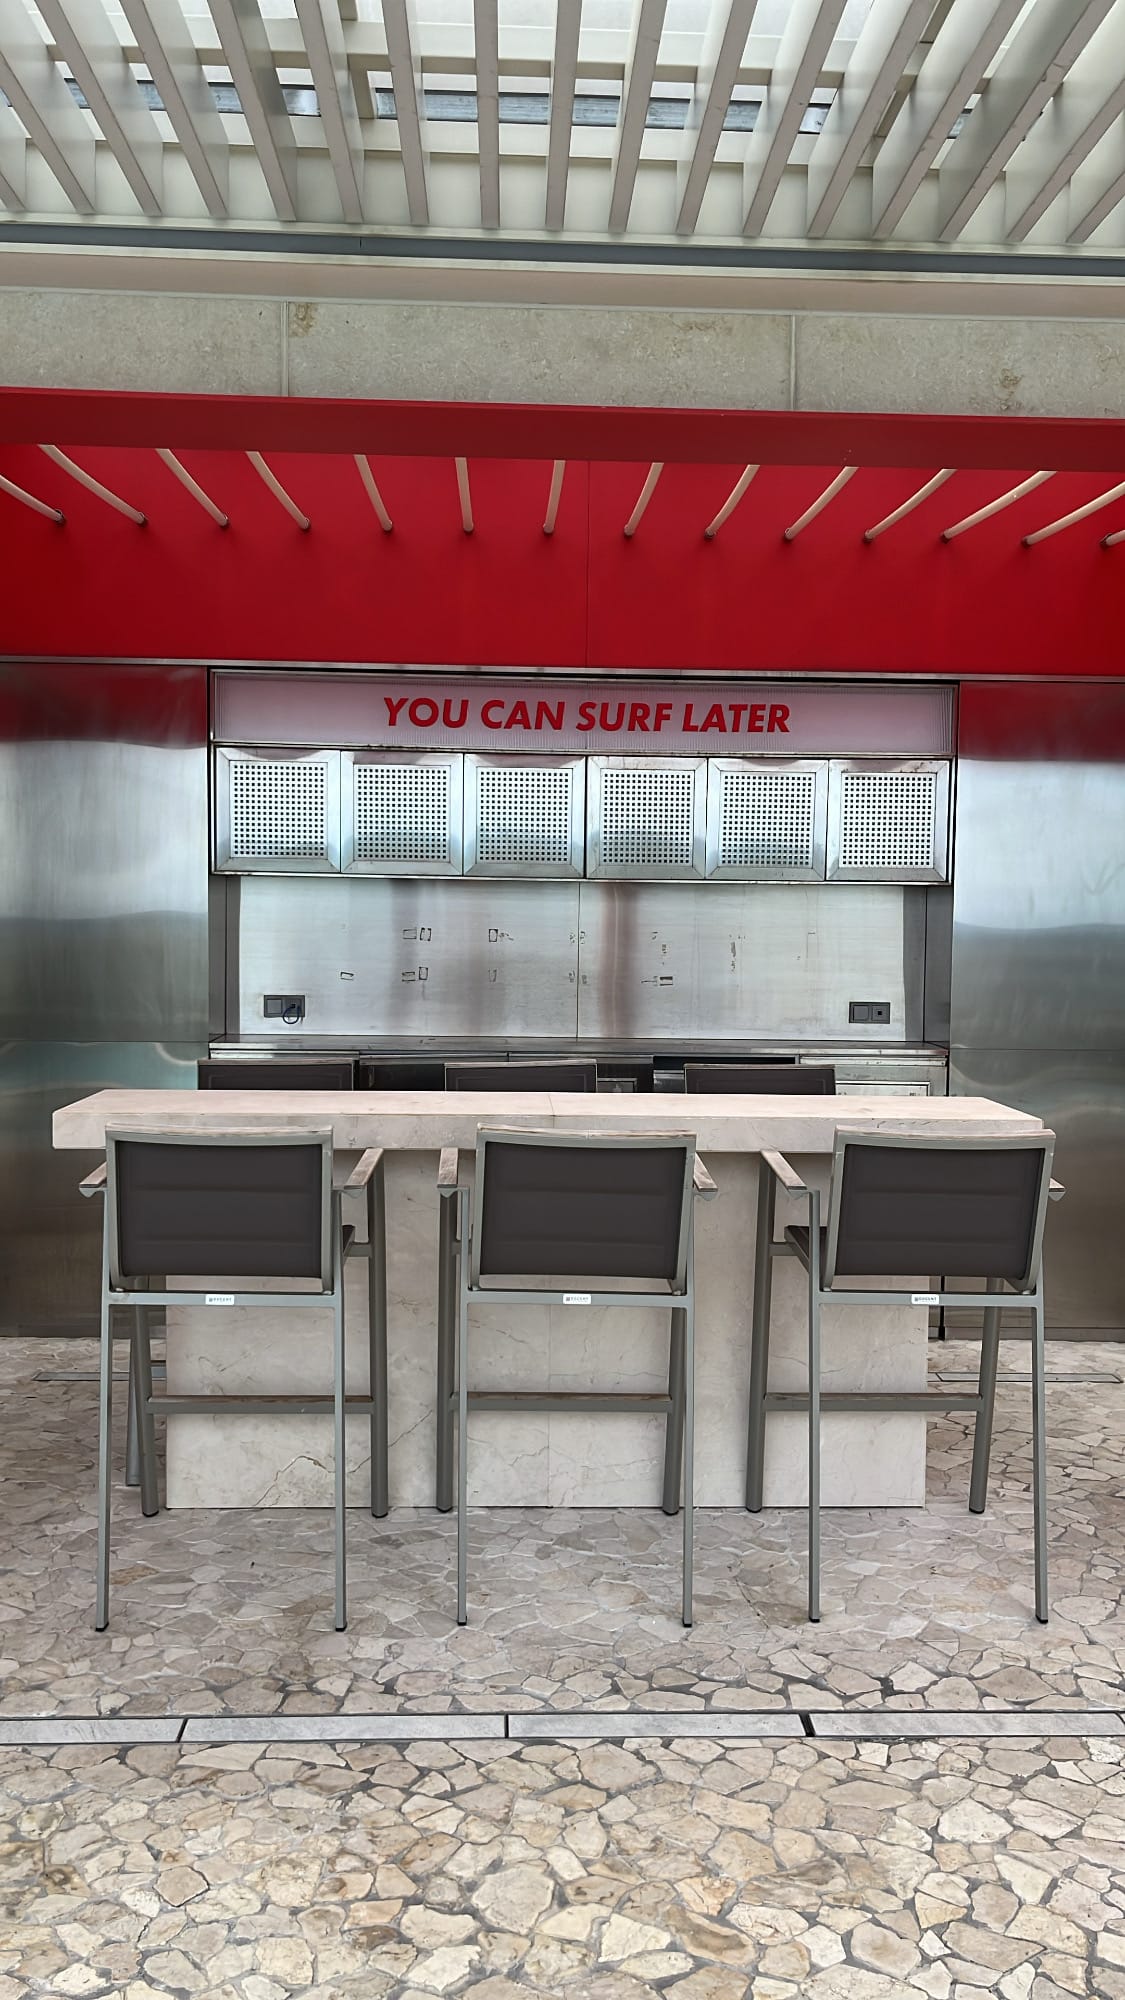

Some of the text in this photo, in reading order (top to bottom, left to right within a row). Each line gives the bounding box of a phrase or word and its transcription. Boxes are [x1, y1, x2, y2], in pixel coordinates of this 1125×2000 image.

[384, 697, 790, 733] YOU CAN SURF LATER
